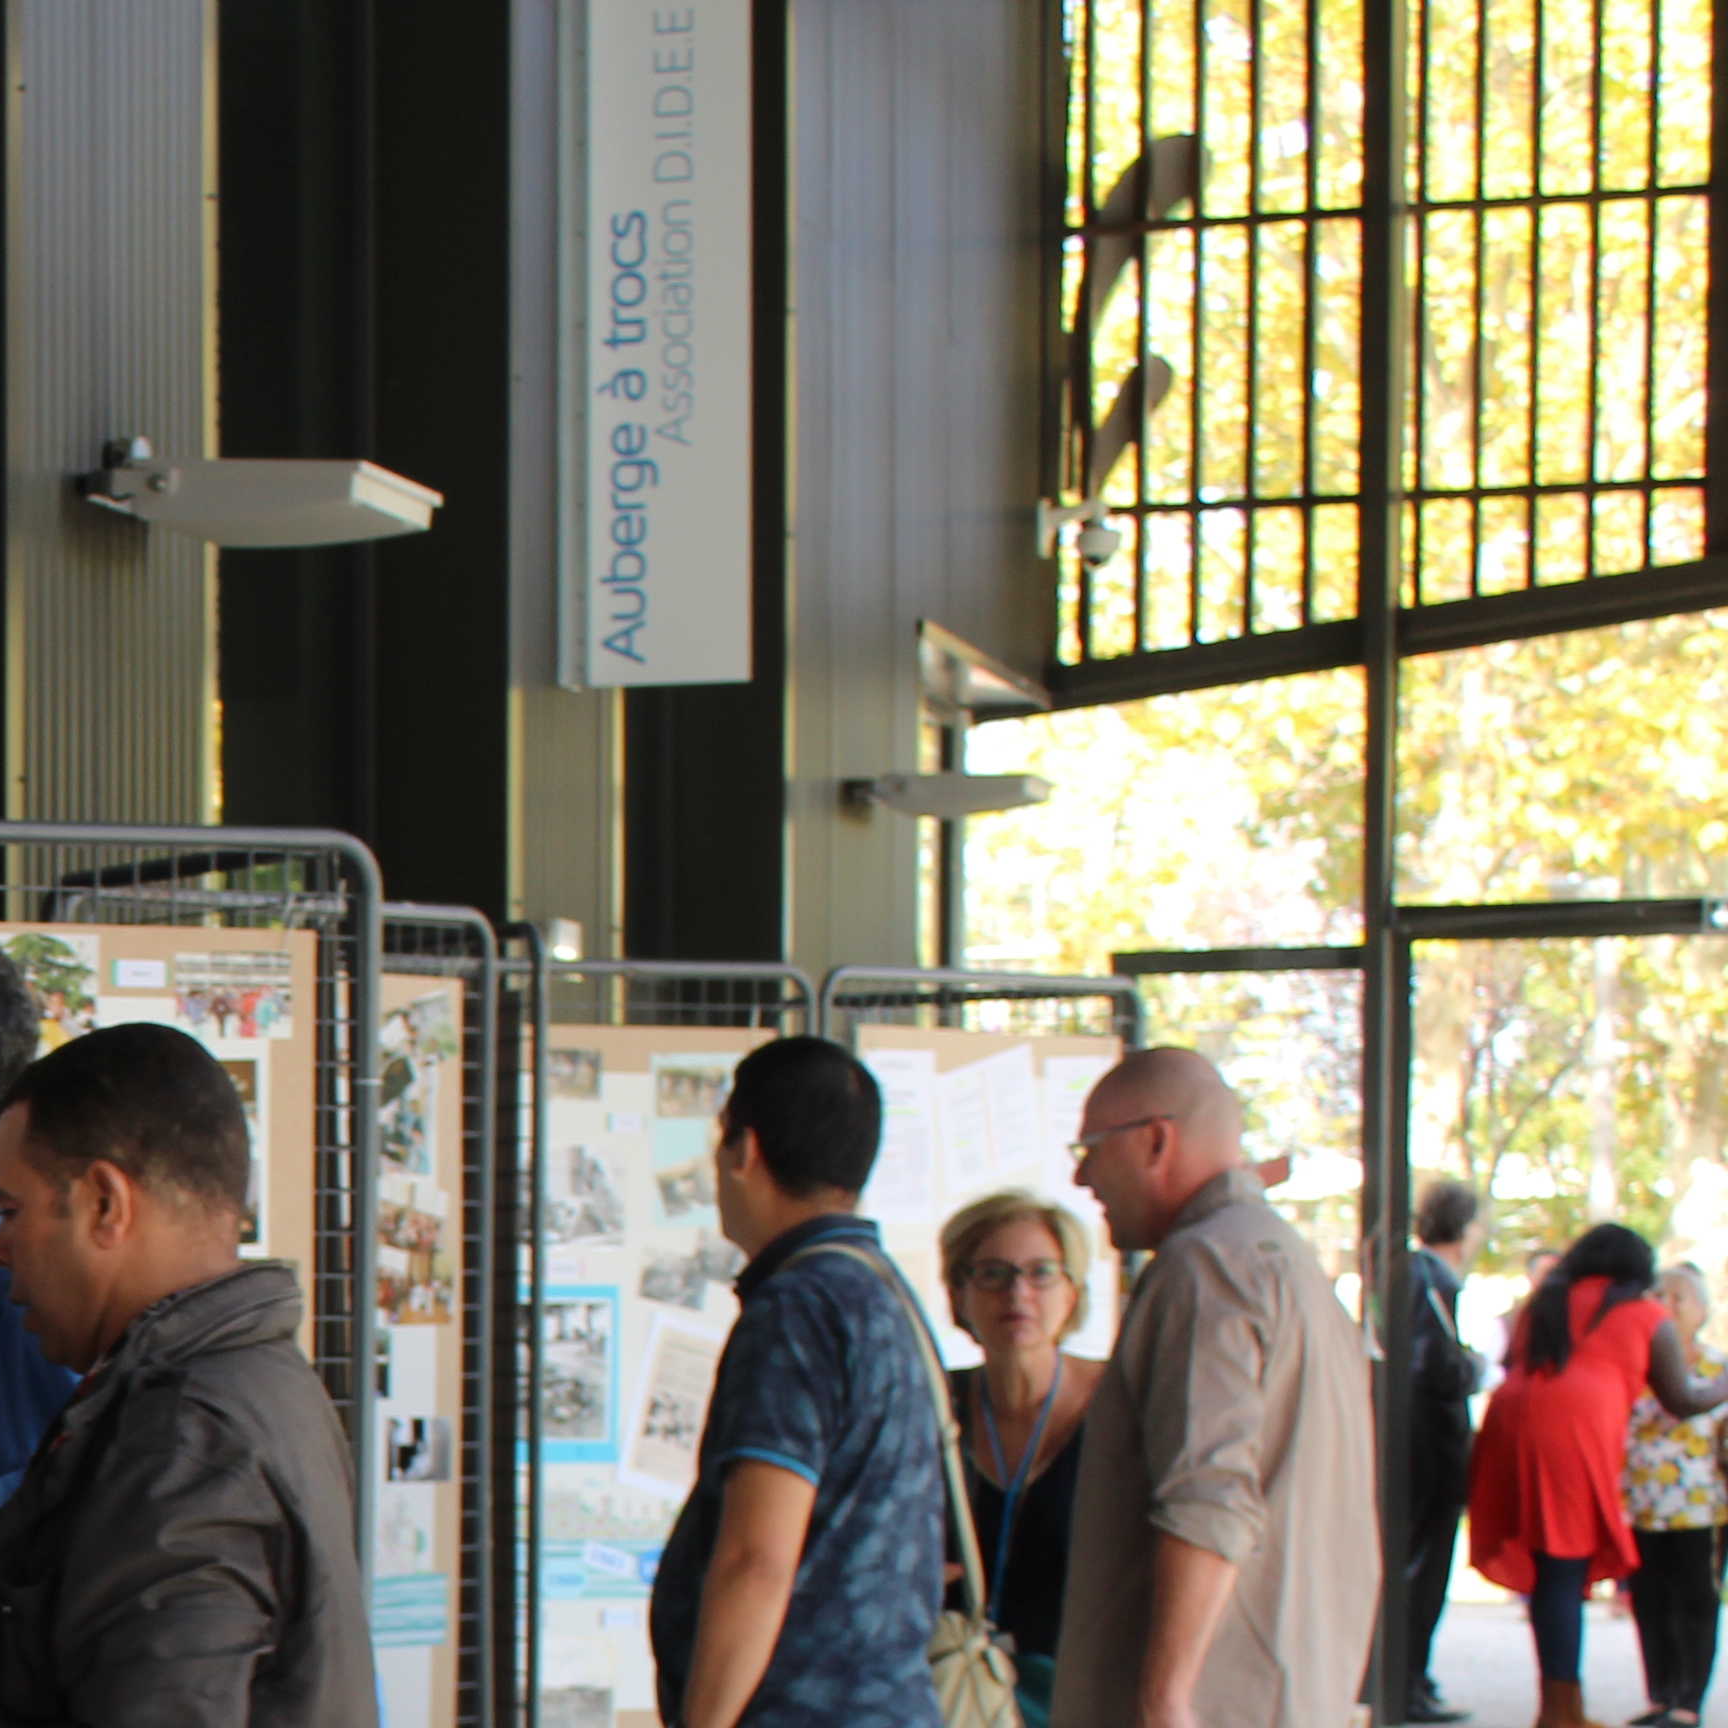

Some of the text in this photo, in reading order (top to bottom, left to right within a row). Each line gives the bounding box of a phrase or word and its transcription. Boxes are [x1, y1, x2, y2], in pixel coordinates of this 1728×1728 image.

[597, 209, 659, 665] Auberge à trocs
[654, 198, 694, 447] Association
